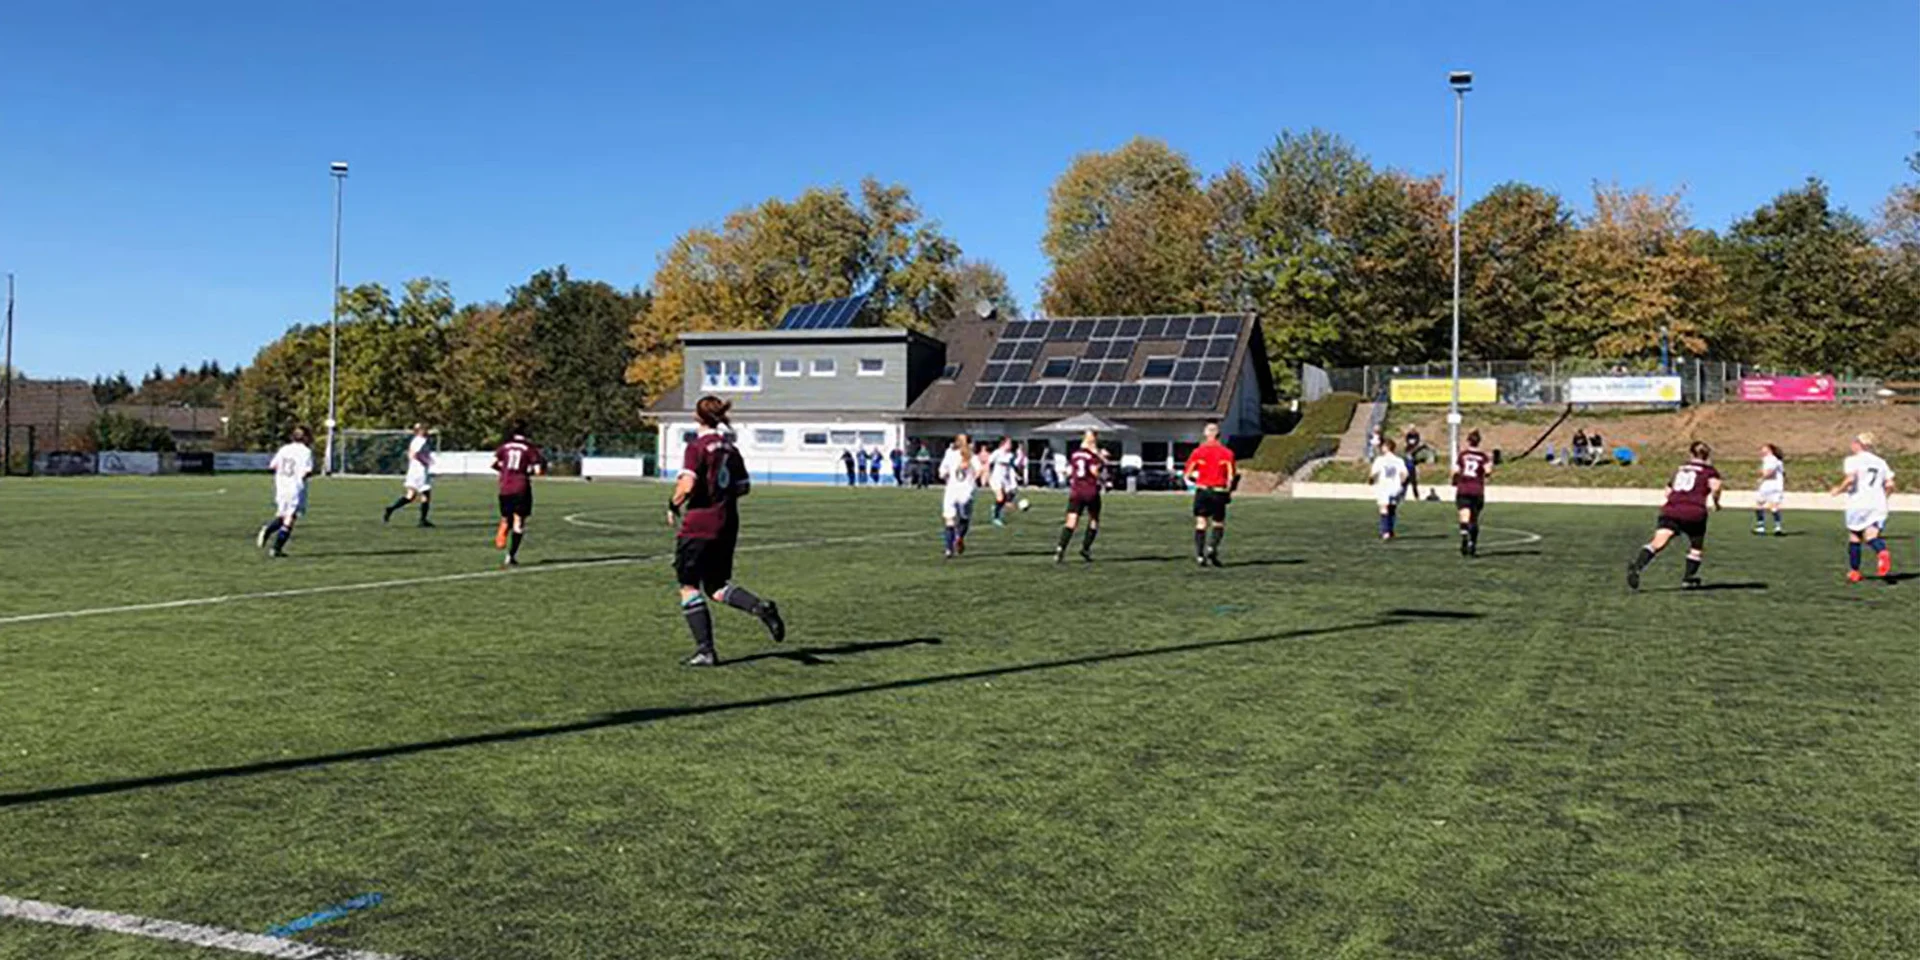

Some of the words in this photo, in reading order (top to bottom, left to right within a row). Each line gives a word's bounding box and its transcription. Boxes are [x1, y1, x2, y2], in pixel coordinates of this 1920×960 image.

[508, 450, 521, 469] 11
[718, 453, 729, 489] 6
[1867, 468, 1878, 486] 7
